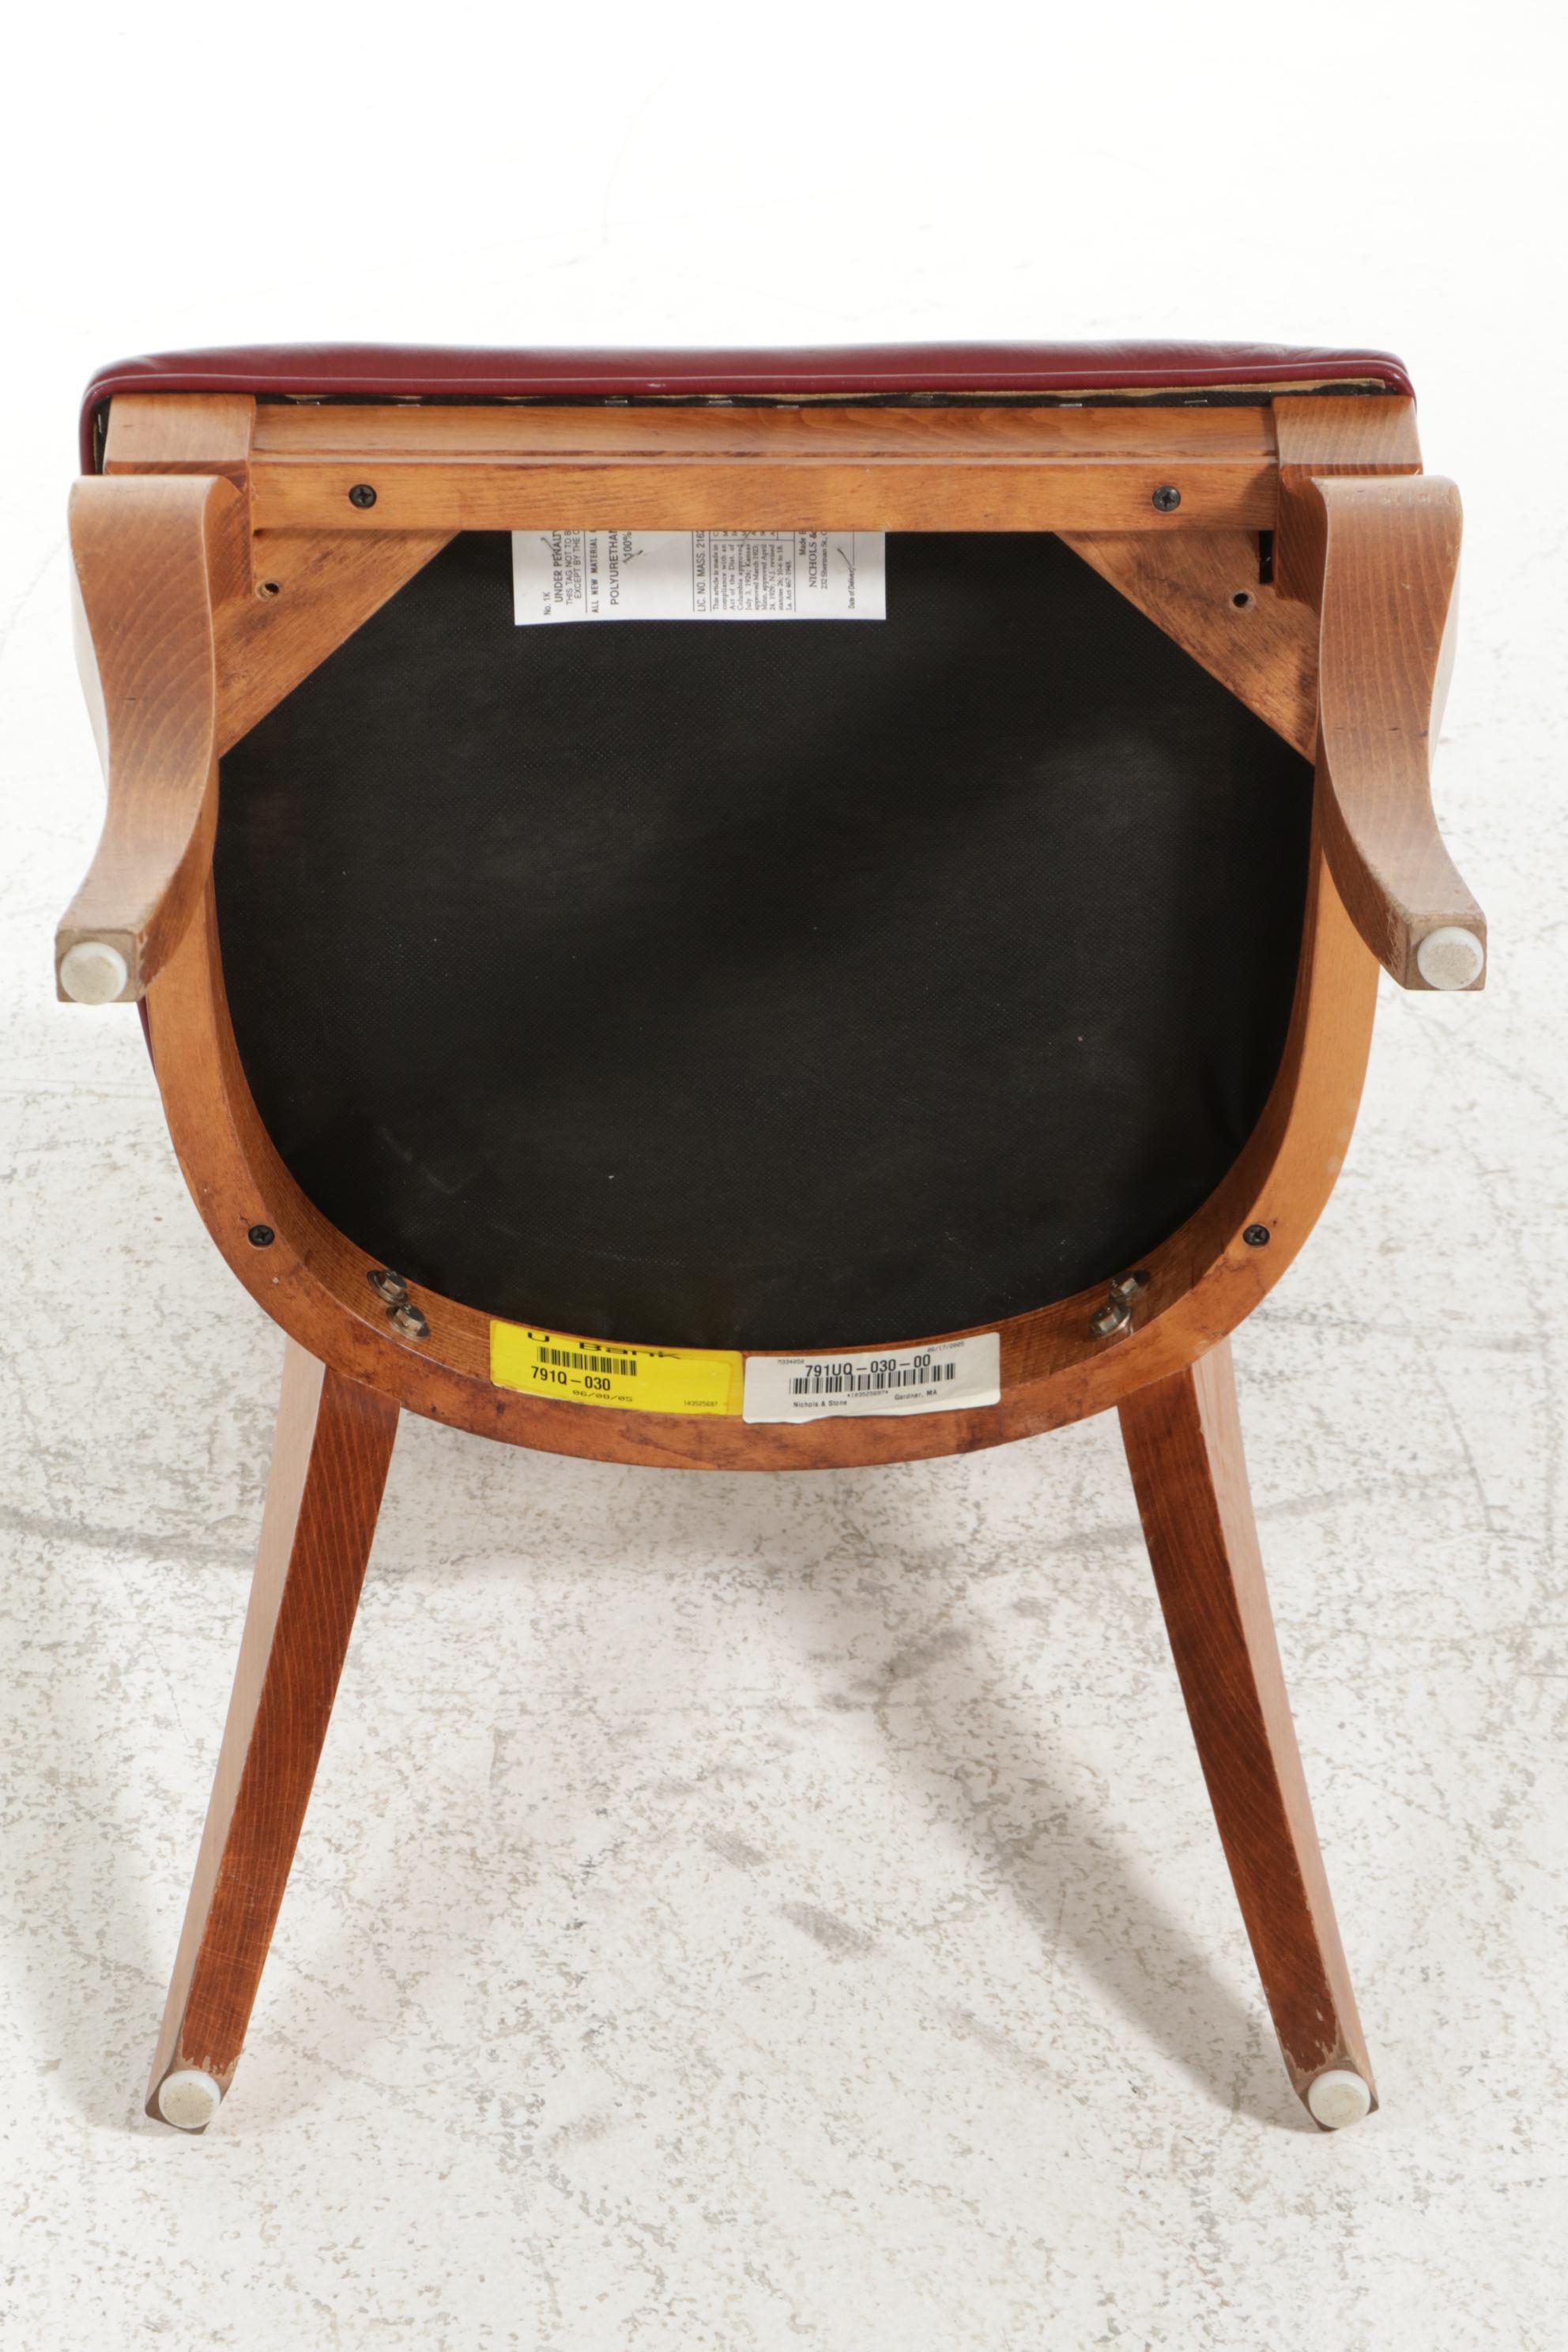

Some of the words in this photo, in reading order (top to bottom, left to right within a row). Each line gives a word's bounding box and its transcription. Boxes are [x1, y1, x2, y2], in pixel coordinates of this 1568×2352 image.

[564, 538, 572, 548] TO
[623, 531, 632, 557] 100%
[722, 544, 726, 552] an
[573, 555, 581, 566] BY
[808, 542, 817, 588] NICHOLS
[553, 570, 564, 602] UNDER
[573, 567, 582, 599] EXCEPT
[543, 591, 551, 601] 1K
[565, 588, 574, 605] THIS
[729, 588, 735, 597] of
[752, 582, 761, 610] approved
